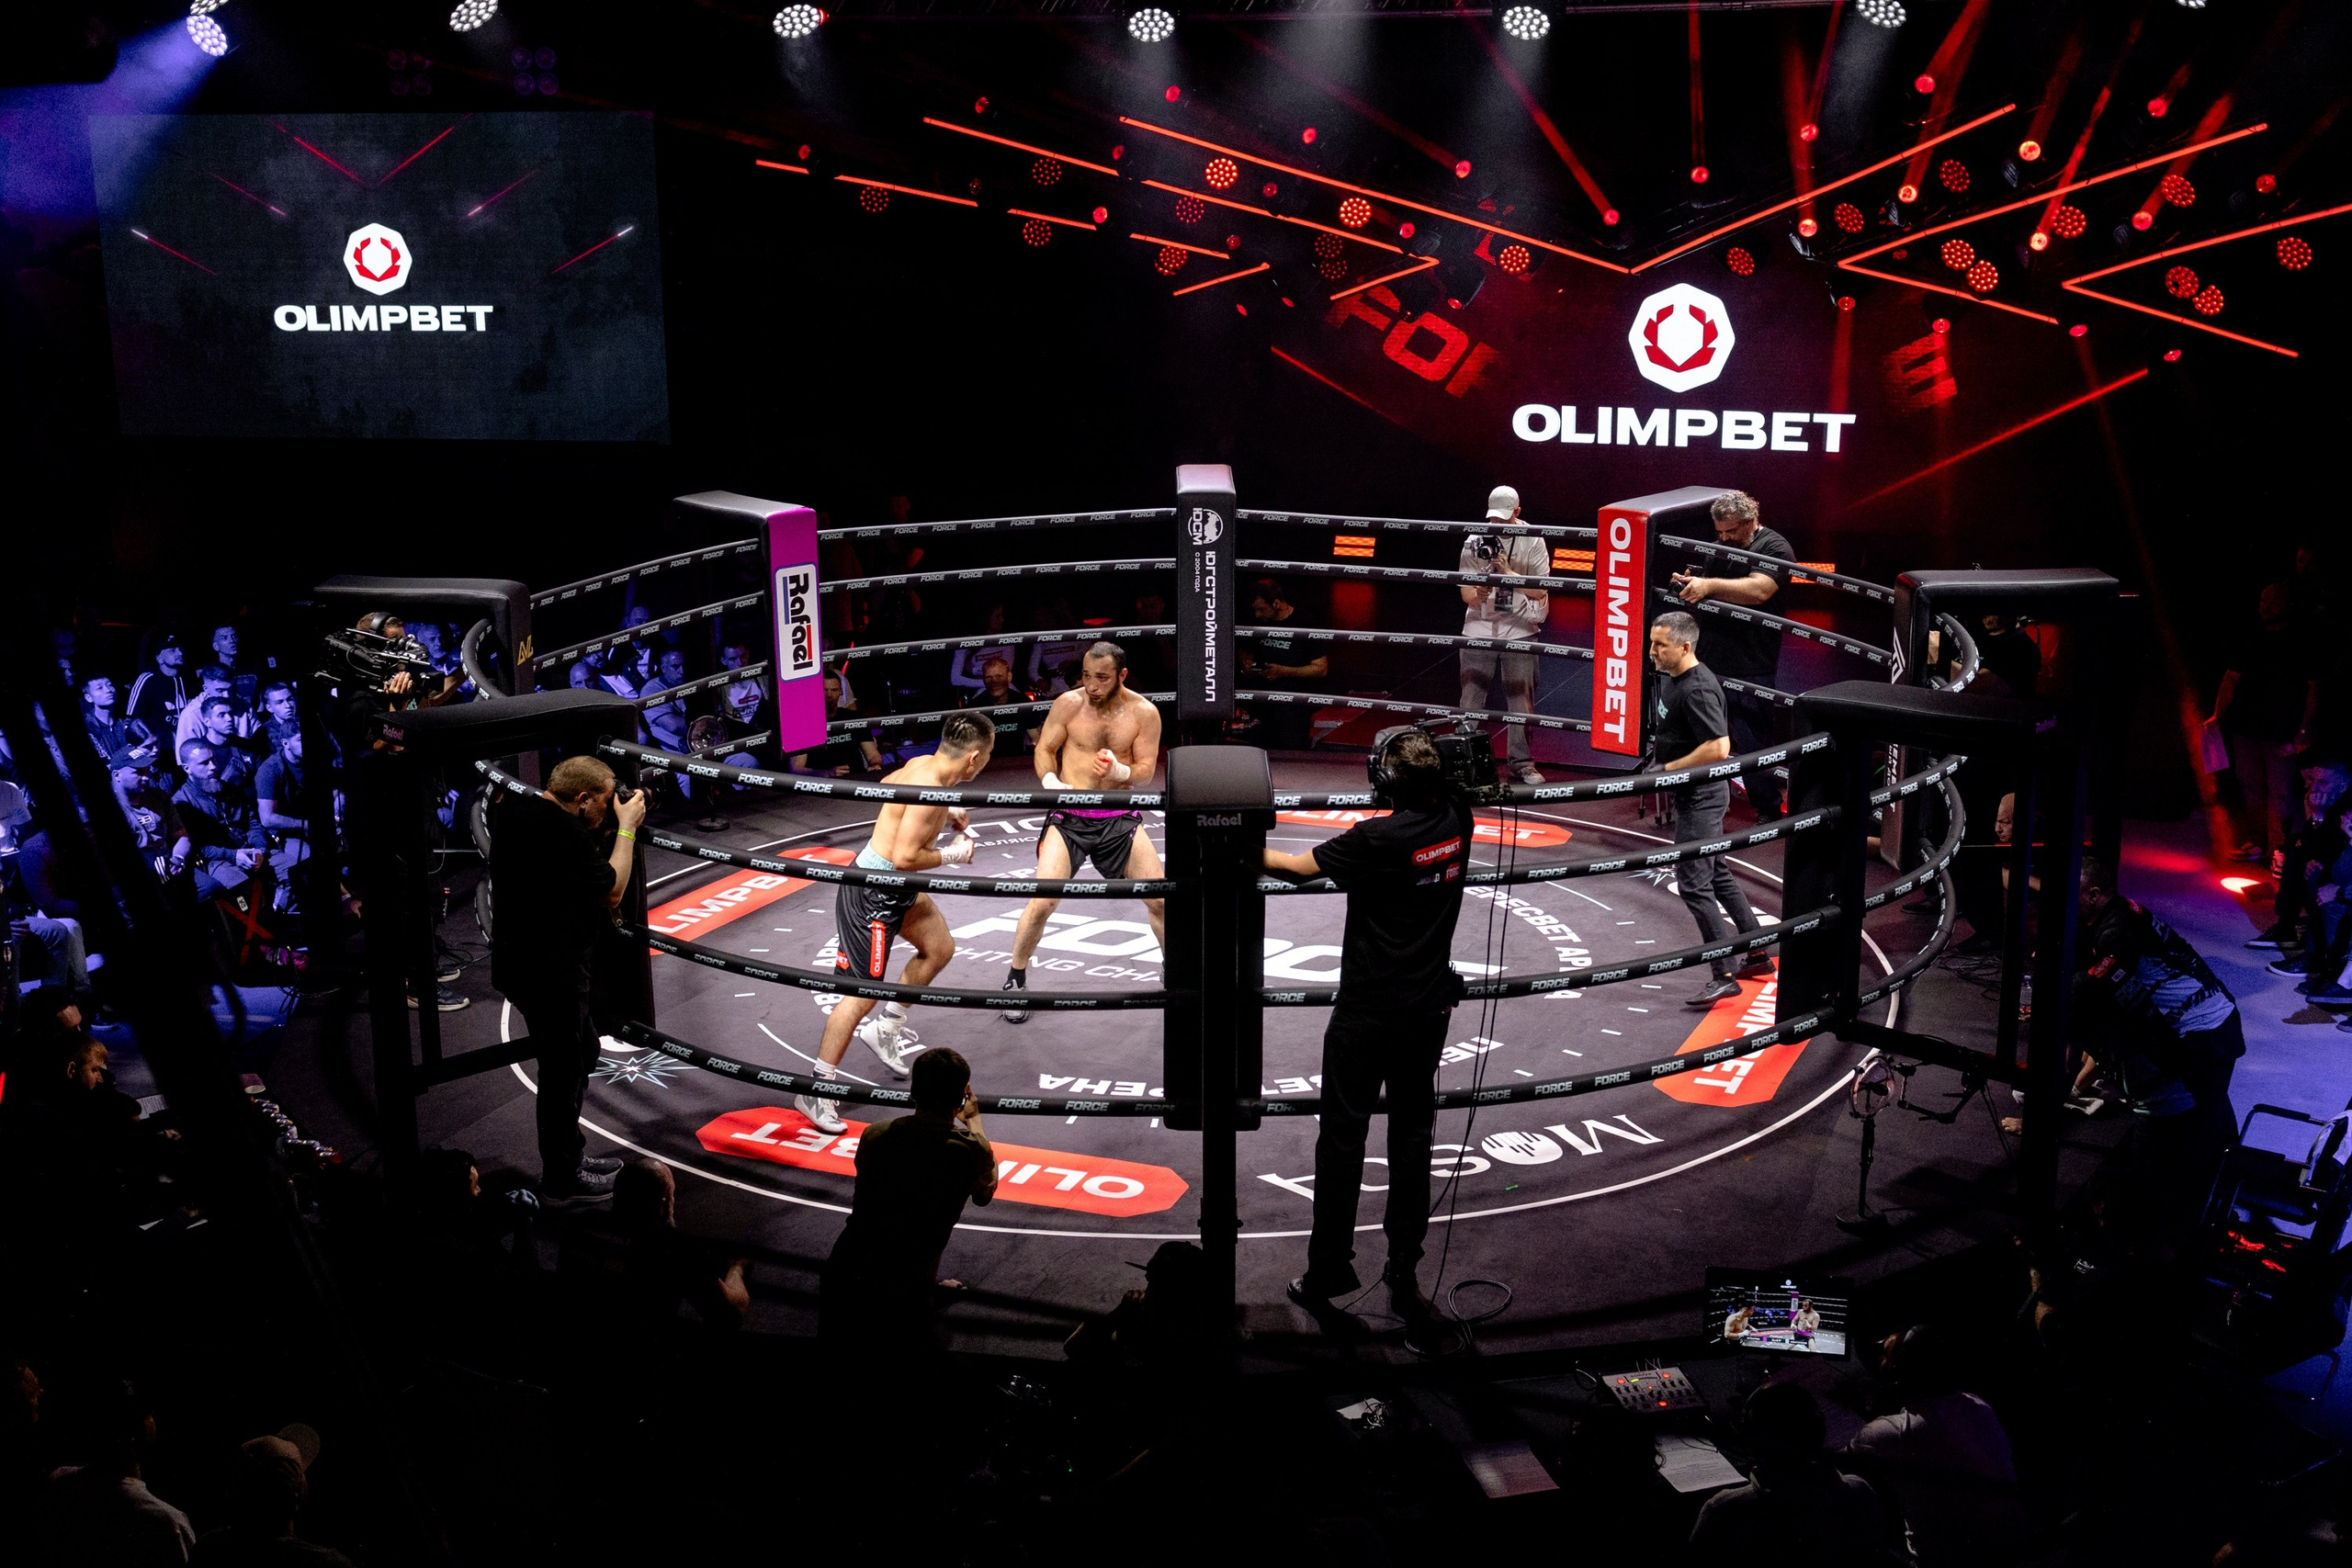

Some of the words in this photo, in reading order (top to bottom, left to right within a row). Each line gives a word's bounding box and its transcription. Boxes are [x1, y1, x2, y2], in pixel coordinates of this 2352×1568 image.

[274, 304, 493, 333] OLIMPBET
[1512, 403, 1857, 453] OLIMPBET
[820, 532, 843, 540] FORCE
[1660, 536, 1683, 548] FORCE
[1694, 545, 1716, 555] FORCE
[1727, 553, 1747, 563] FORCE
[1789, 569, 1807, 578] FORCE
[612, 574, 629, 584] FORCE
[671, 558, 691, 568] FORCE
[736, 544, 757, 553] FORCE
[612, 634, 629, 645] FORCE
[671, 615, 690, 626] FORCE
[736, 598, 757, 608] FORCE
[788, 572, 813, 671] Rafael
[1205, 551, 1217, 702] ЮГСТРОЙМЕТАЛЛ
[1603, 517, 1632, 744] OLIMPBET
[1664, 594, 1685, 605] FORCE
[1698, 604, 1720, 613] FORCE
[1731, 612, 1751, 620] FORCE
[1792, 628, 1810, 639] FORCE
[847, 650, 871, 659] FORCE
[647, 696, 665, 707] FORCE
[676, 687, 696, 698] FORCE
[708, 676, 729, 687] FORCE
[741, 667, 763, 678] FORCE
[918, 715, 941, 723] FORCE
[1151, 694, 1176, 702] FORCE
[1723, 681, 1744, 691] FORCE
[1755, 690, 1774, 701] FORCE
[714, 744, 734, 755] FORCE
[746, 737, 766, 747] FORCE
[827, 733, 852, 745] ORCE
[994, 723, 1018, 733] ORCE
[641, 754, 670, 767] FORCE
[687, 764, 719, 777] FORCE
[739, 773, 774, 786] FORCE
[795, 781, 832, 794] FORCE
[854, 787, 896, 798] FORCE
[919, 791, 962, 802] FORCE
[987, 794, 1032, 803] FORCE
[1057, 795, 1103, 804] FORCE
[1328, 795, 1371, 805] FORCE
[1534, 787, 1574, 799] FORCE
[1597, 782, 1634, 794] FORCE
[1656, 773, 1690, 786] FORCE
[1710, 762, 1740, 777] FORCE
[1758, 750, 1786, 766] FORCE
[1802, 739, 1827, 753] FORCE
[1196, 813, 1242, 828] Rafael
[652, 837, 682, 851] FORCE
[698, 848, 731, 862] FORCE
[751, 859, 786, 872] FORCE
[807, 868, 843, 880] FORCE
[865, 874, 906, 886] FORCE
[929, 879, 970, 890] FORCE
[995, 882, 1038, 893] FORCE
[1063, 884, 1107, 893] FORCE
[1416, 840, 1461, 863] OLIMPBET
[1528, 868, 1567, 879] FORCE
[1589, 861, 1625, 873] FORCE
[1646, 852, 1680, 864] FORCE
[1700, 840, 1732, 855] FORCE
[1749, 829, 1779, 842] FORCE
[1794, 816, 1820, 831] FORCE
[1463, 886, 1582, 942] ЕРЕСВЕТ
[1531, 977, 1569, 990] FORCE
[1591, 969, 1628, 982] FORCE
[1649, 958, 1683, 973] FORCE
[1702, 946, 1733, 961] FORCE
[1750, 933, 1778, 948] FORCE
[1793, 919, 1819, 934] FORCE
[662, 1042, 693, 1057] FORCE
[707, 1057, 741, 1074] FORCE
[757, 1071, 794, 1086] FORCE
[812, 1081, 851, 1095] FORCE
[870, 1089, 910, 1101] FORCE
[998, 1099, 1041, 1109] FORCE
[1066, 1100, 1109, 1111] FORCE
[1535, 1081, 1573, 1095] FORCE
[1595, 1072, 1631, 1086] FORCE
[1651, 1060, 1684, 1075] FORCE
[1704, 1046, 1735, 1062] FORCE
[1751, 1032, 1779, 1048] FORCE
[1793, 1018, 1818, 1033] FORCE
